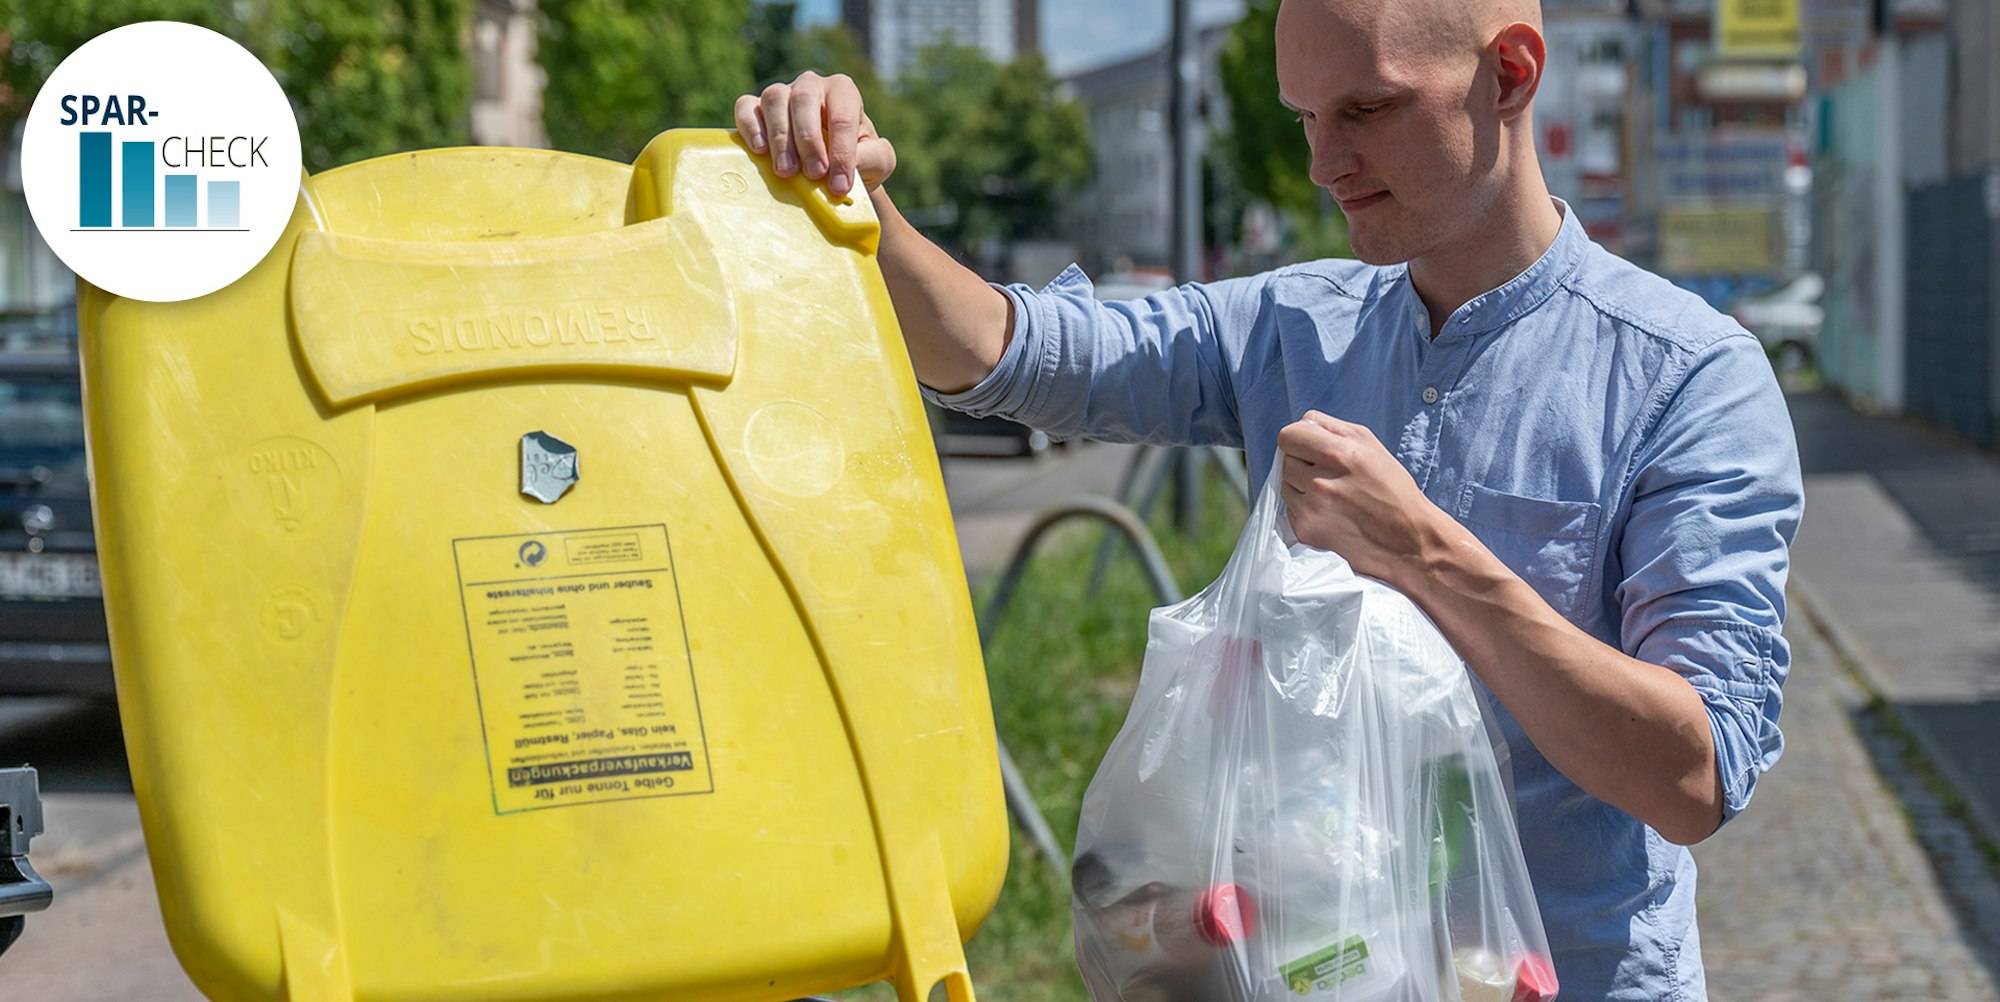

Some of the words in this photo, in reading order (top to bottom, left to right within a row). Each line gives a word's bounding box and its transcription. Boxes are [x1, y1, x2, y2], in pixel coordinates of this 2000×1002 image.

[249, 449, 317, 474] KLIKO
[557, 584, 585, 597] ohne
[588, 582, 609, 594] und
[614, 579, 653, 591] Sauber
[486, 586, 554, 600] Inhaltsreste
[651, 725, 676, 738] kein
[515, 733, 569, 749] Restmüll
[511, 753, 692, 784] Verkaufsverpackungen
[587, 780, 630, 795] Tonne
[634, 776, 675, 791] Gelbe
[533, 788, 555, 801] für
[558, 785, 583, 797] nur
